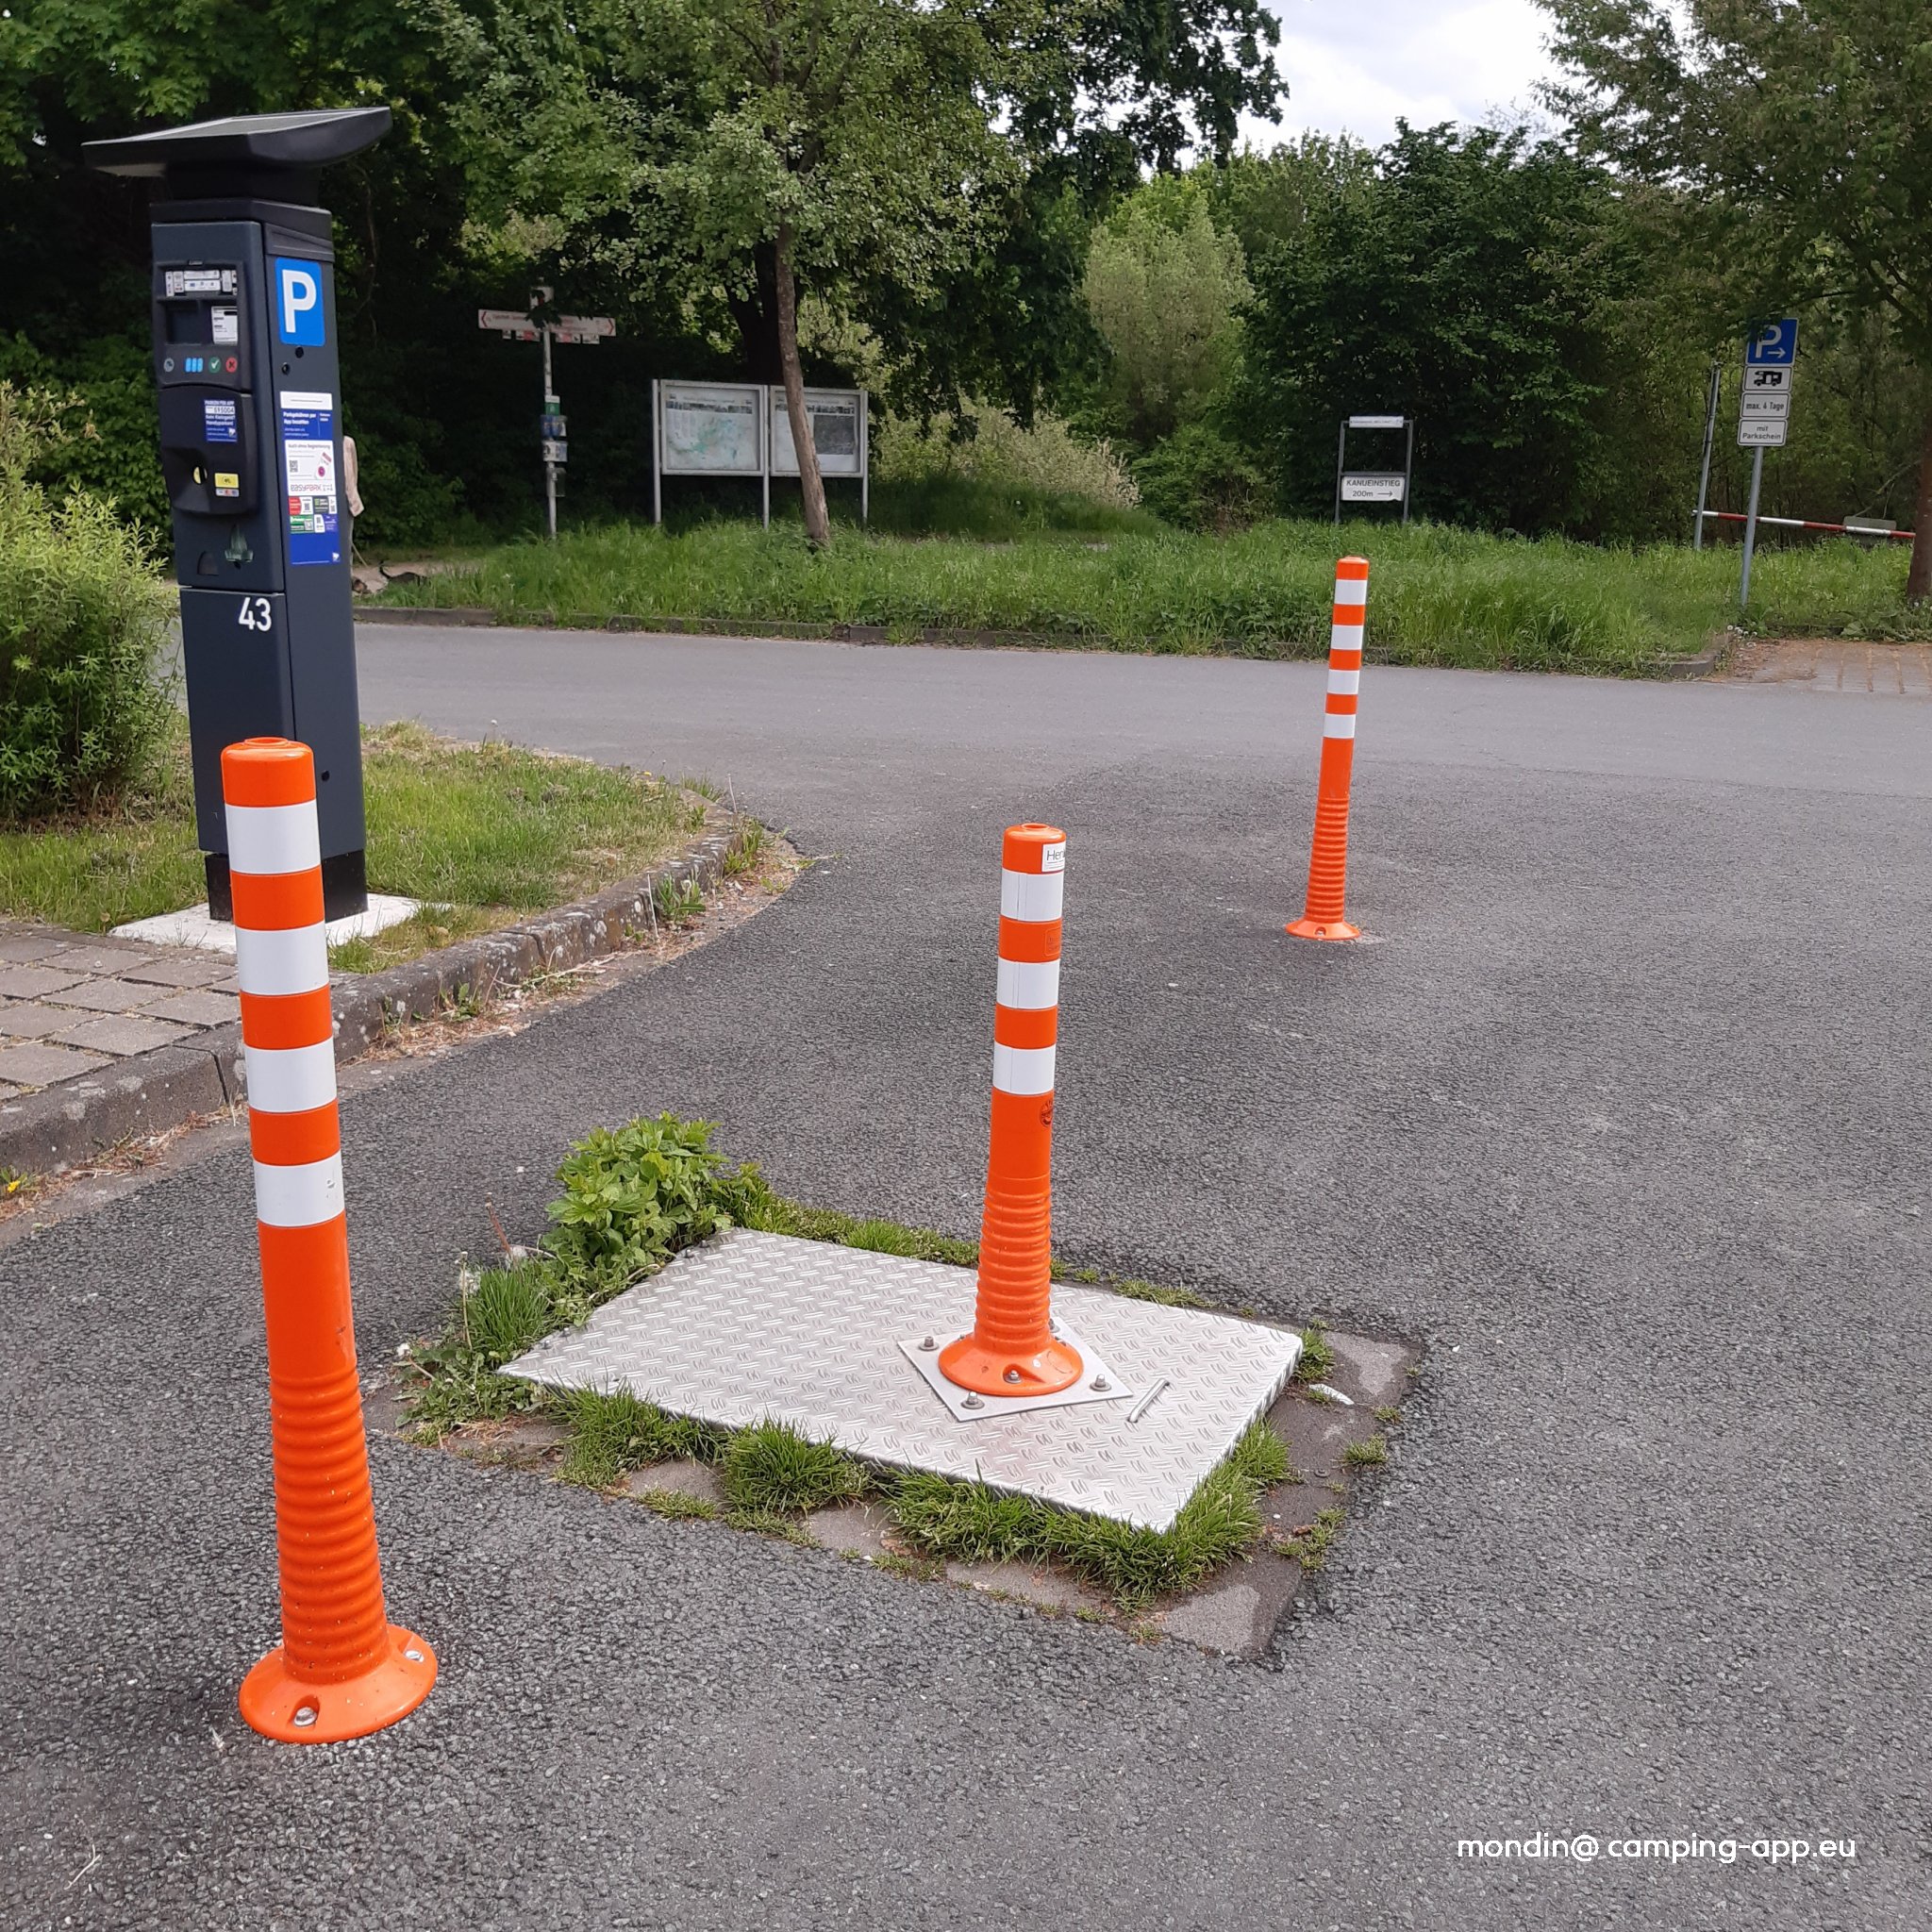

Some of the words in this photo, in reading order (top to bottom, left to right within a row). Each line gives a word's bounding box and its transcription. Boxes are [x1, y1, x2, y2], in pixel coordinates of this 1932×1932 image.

[281, 269, 317, 334] P
[1755, 324, 1782, 358] P
[1769, 402, 1785, 411] Tage
[239, 596, 272, 632] 43
